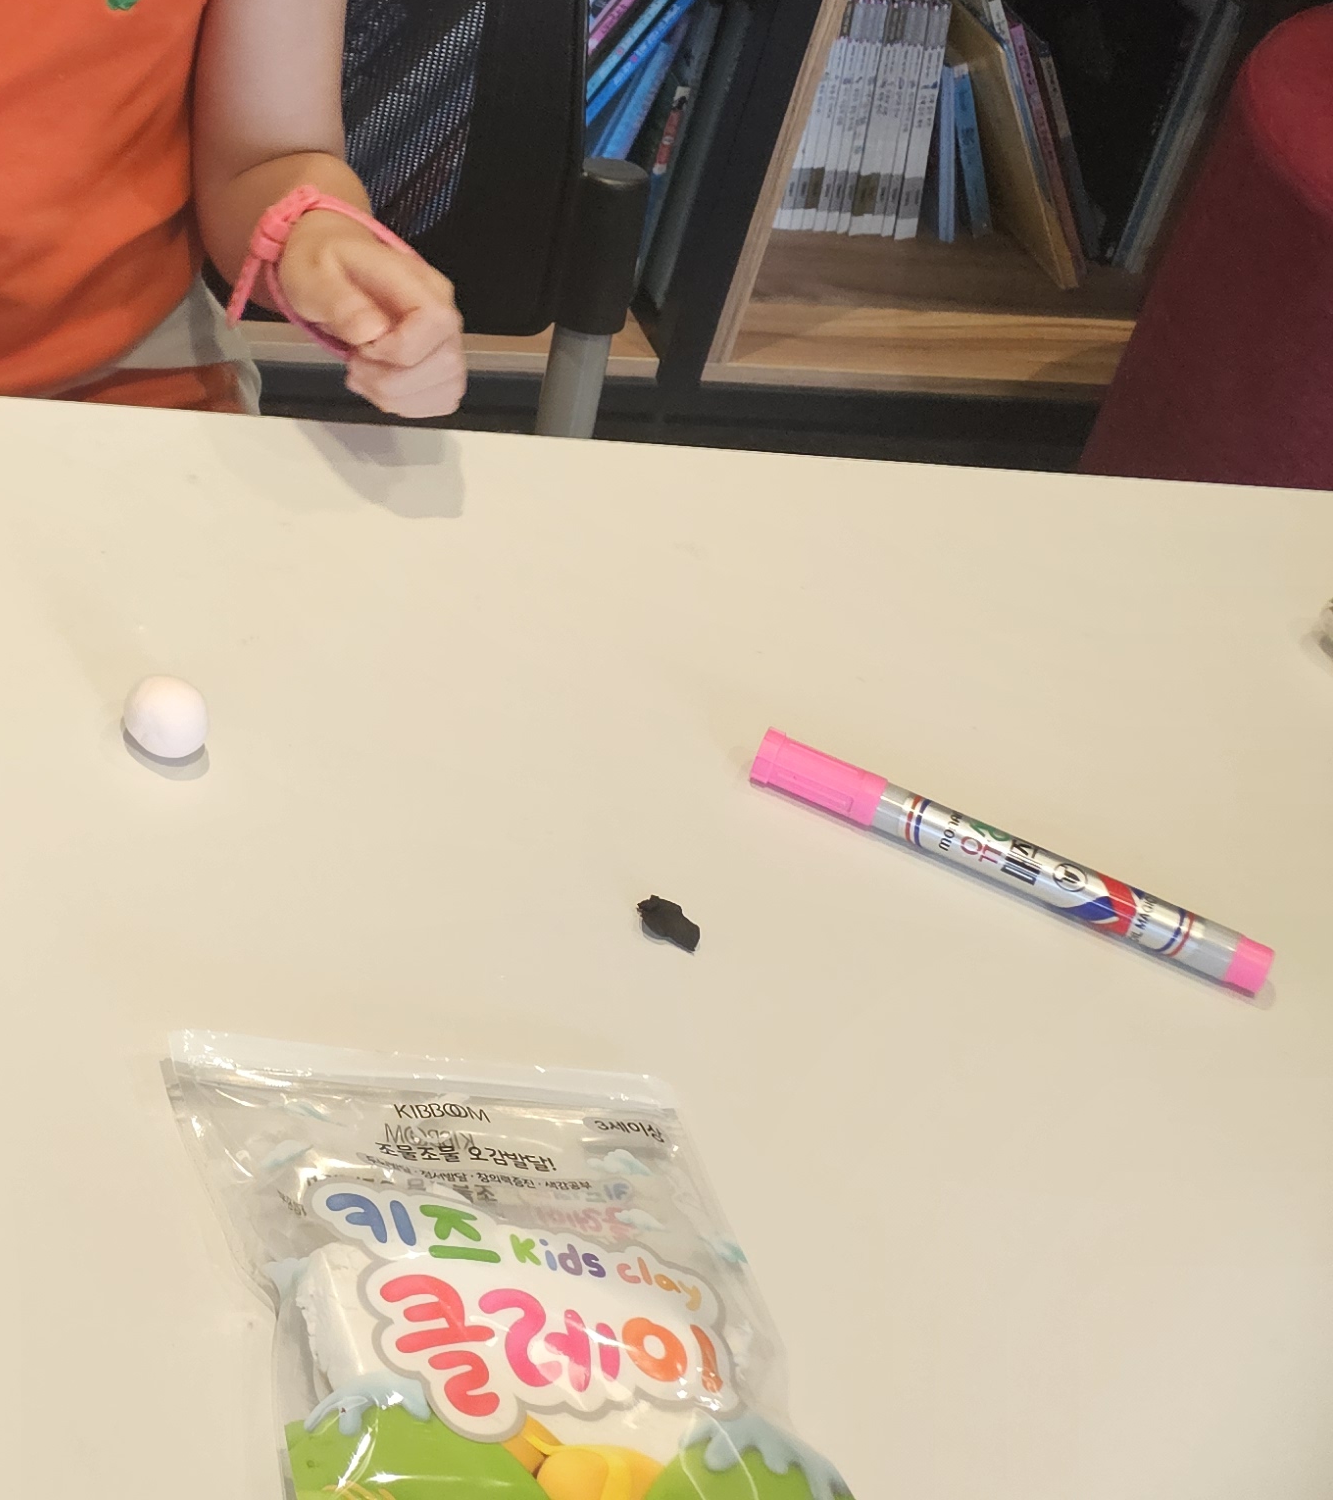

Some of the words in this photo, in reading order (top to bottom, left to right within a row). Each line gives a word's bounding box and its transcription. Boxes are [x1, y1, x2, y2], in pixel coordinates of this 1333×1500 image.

[393, 1102, 492, 1124] KIBBOOM
[594, 1118, 666, 1145] 3세이상
[469, 1146, 558, 1172] 오감발달!
[326, 1190, 501, 1264] 키즈
[615, 1257, 702, 1312] clay
[380, 1273, 725, 1418] 클레이
